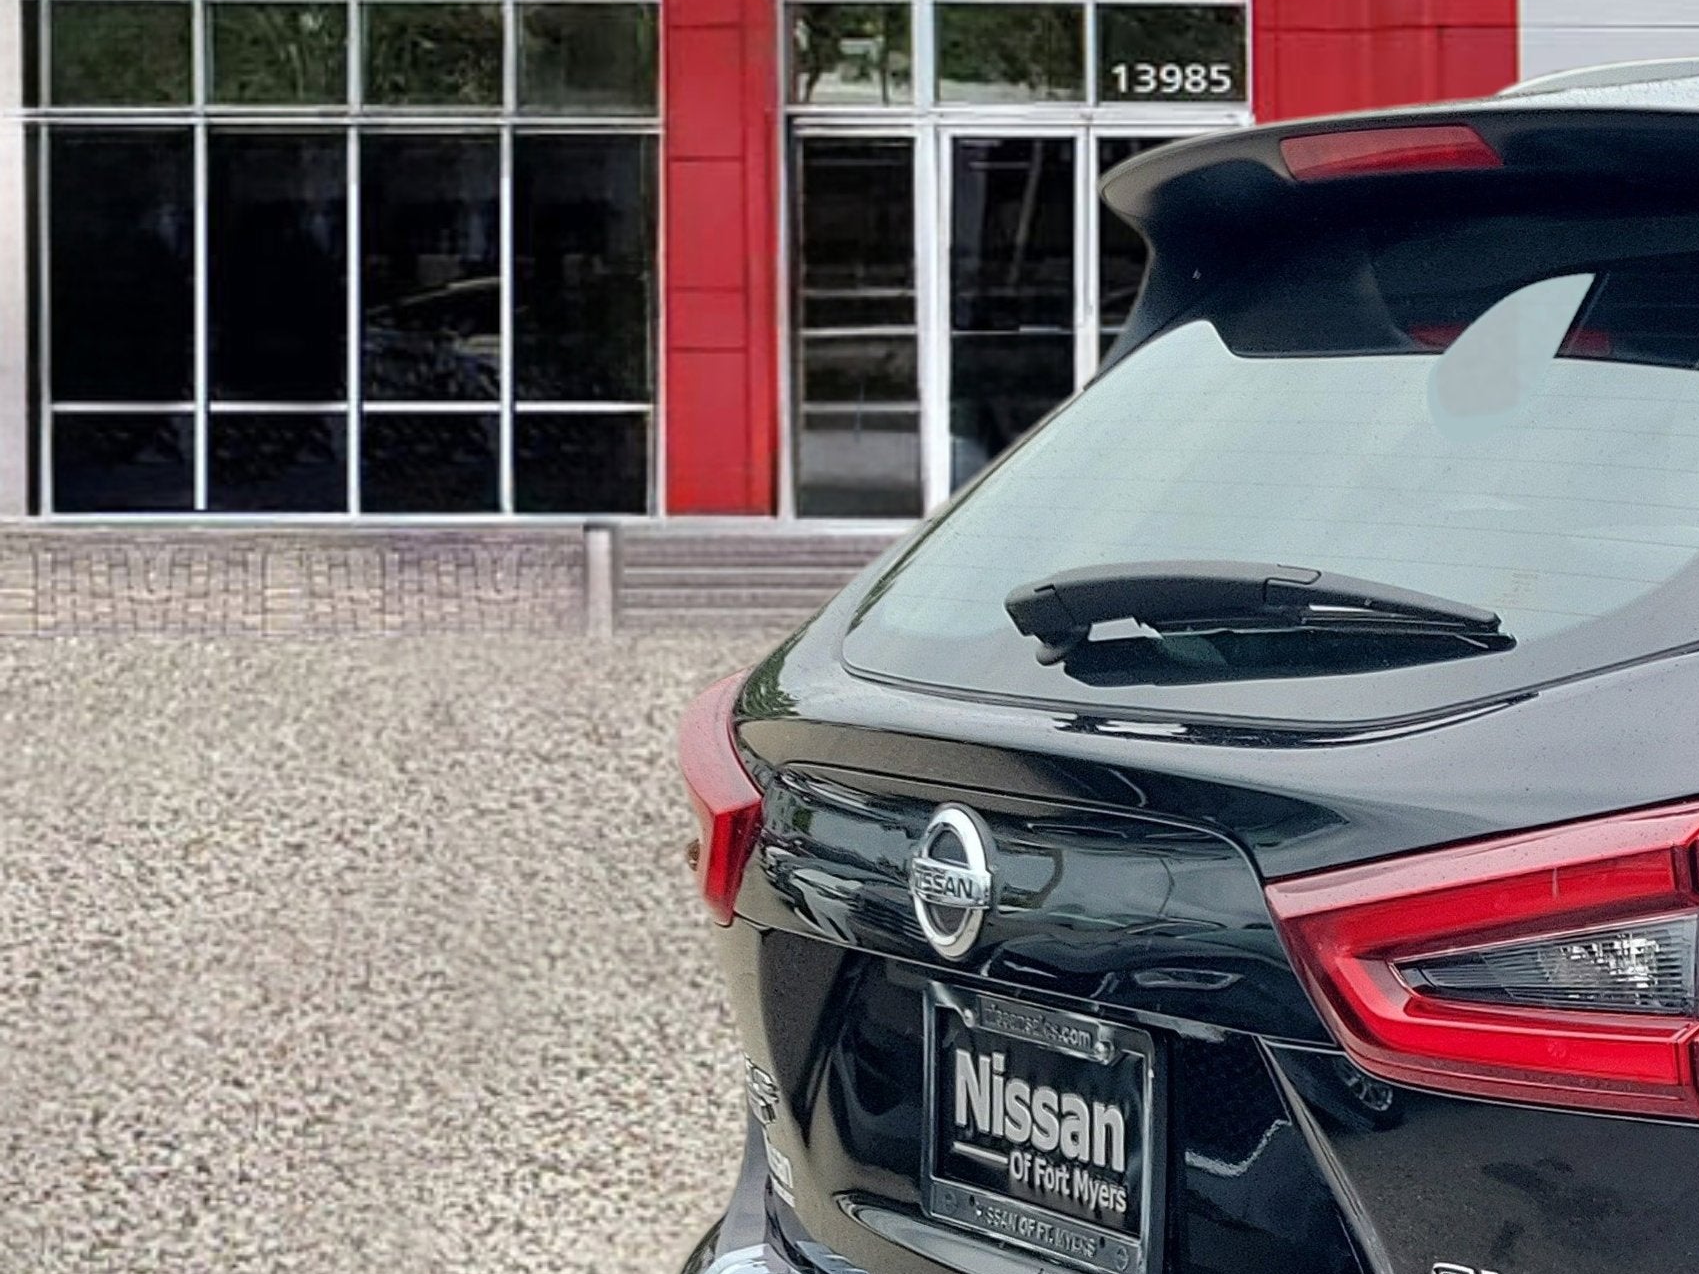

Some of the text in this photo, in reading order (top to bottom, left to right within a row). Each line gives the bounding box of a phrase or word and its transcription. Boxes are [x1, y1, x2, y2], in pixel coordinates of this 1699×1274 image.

[1111, 63, 1232, 93] 13985
[914, 872, 973, 899] ISSAN
[955, 1048, 1126, 1172] Nissan
[1009, 1151, 1127, 1212] Of Fort Myers
[974, 1201, 1017, 1232] SSAN
[1019, 1213, 1036, 1238] OF
